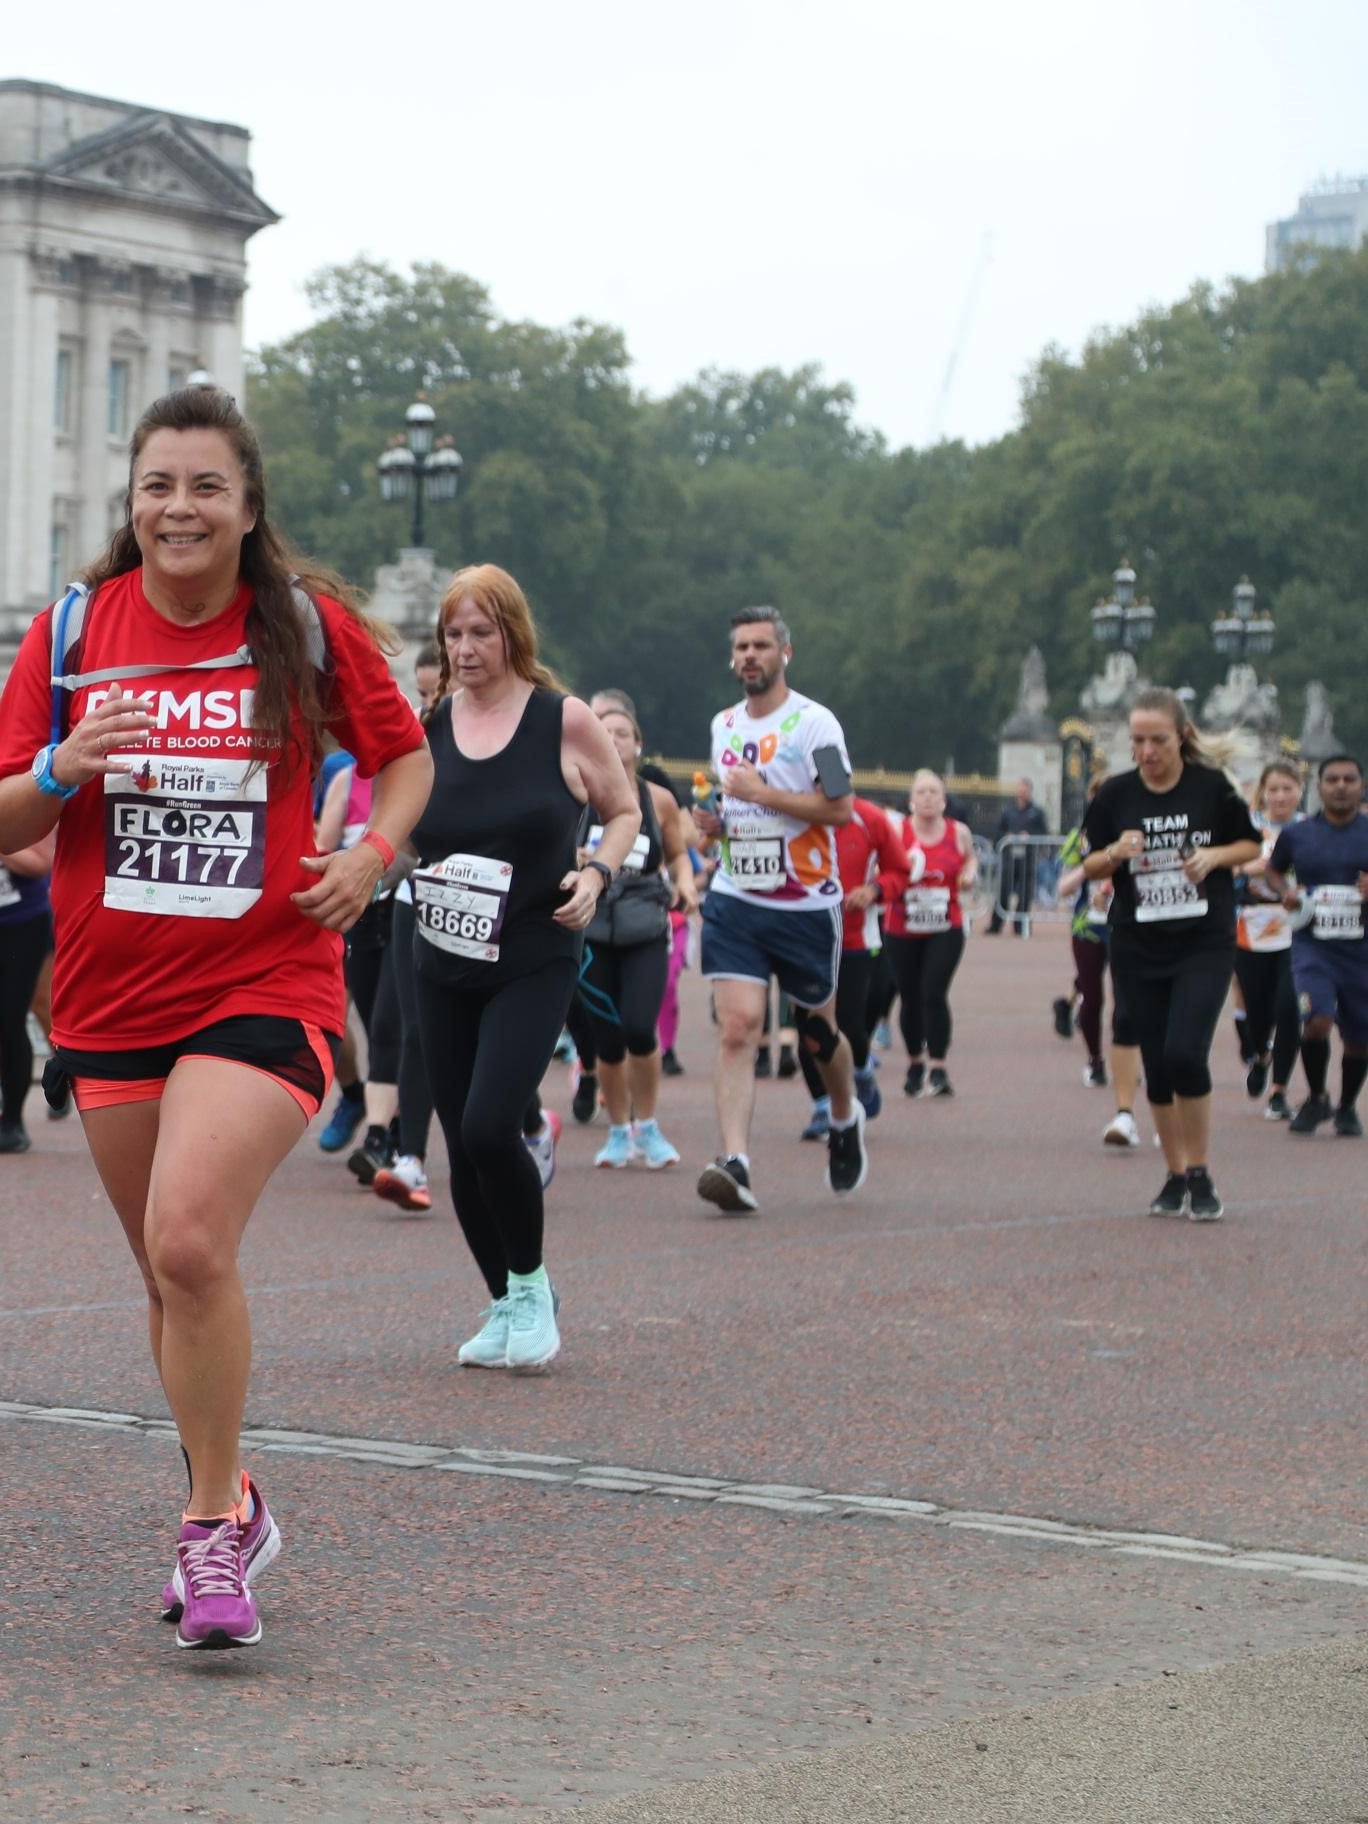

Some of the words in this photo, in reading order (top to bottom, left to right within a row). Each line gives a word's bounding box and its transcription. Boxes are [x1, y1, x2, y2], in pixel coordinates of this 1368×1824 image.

[167, 736, 221, 748] BLOOD
[161, 763, 182, 772] Royal
[184, 764, 205, 773] Parks
[160, 773, 204, 792] Half
[120, 808, 241, 840] FLORA
[1142, 813, 1189, 833] TEAM
[117, 839, 248, 885] 21177
[445, 864, 473, 879] Half
[417, 902, 493, 942] 18669
